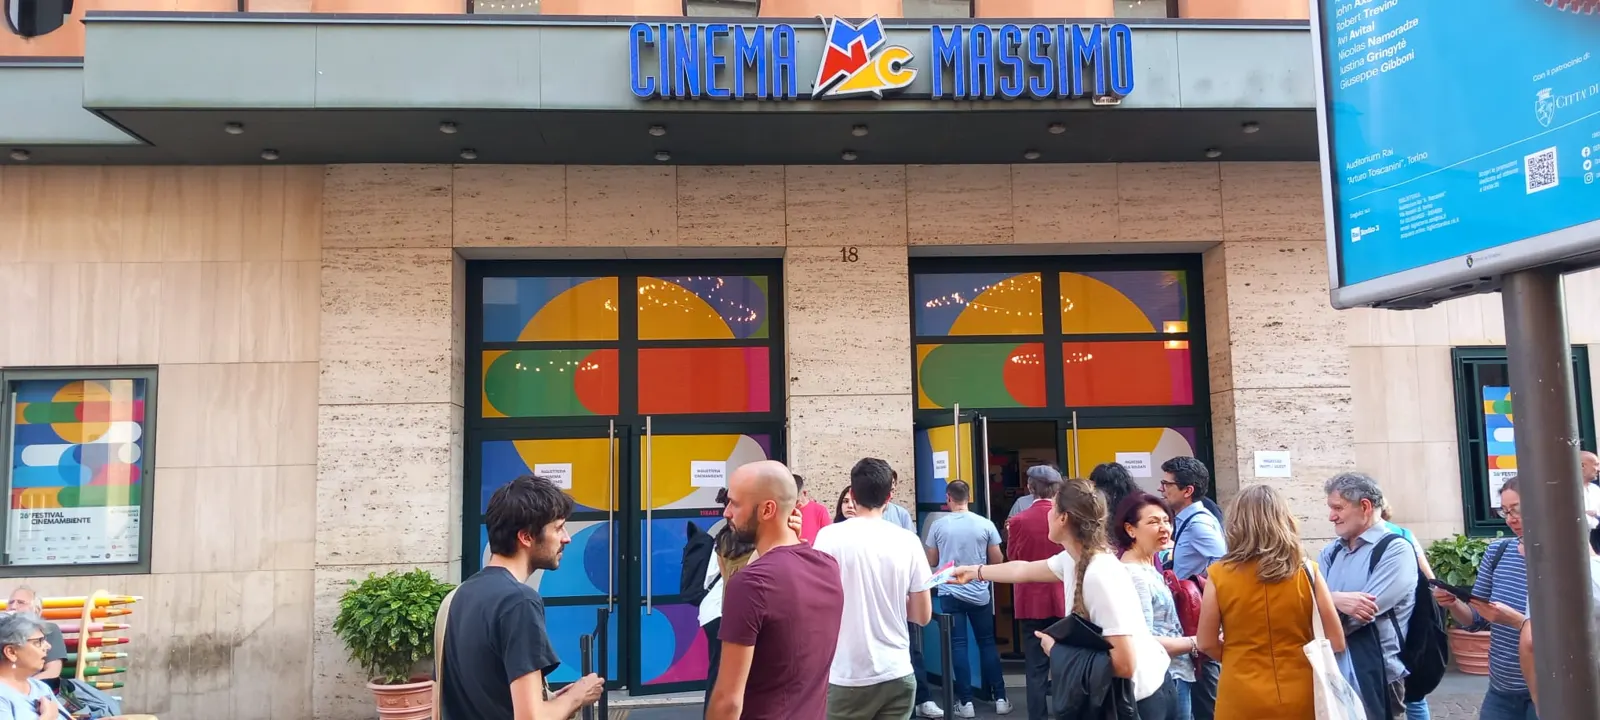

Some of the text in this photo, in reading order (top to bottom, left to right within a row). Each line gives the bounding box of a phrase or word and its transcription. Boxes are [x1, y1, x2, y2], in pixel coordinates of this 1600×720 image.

[1336, 14, 1361, 32] Robert
[1337, 21, 1375, 47] Avi Avital
[1338, 18, 1419, 61] Nicolas Namoradze
[629, 22, 798, 97] CINEMA
[931, 23, 1135, 97] MASSIMO
[1340, 48, 1415, 90] Giuseppe Gibboni
[1533, 73, 1545, 81] Con
[1589, 84, 1599, 96] DI
[1346, 152, 1380, 171] Auditorium
[1407, 151, 1428, 164] Torino
[840, 246, 858, 262] 18
